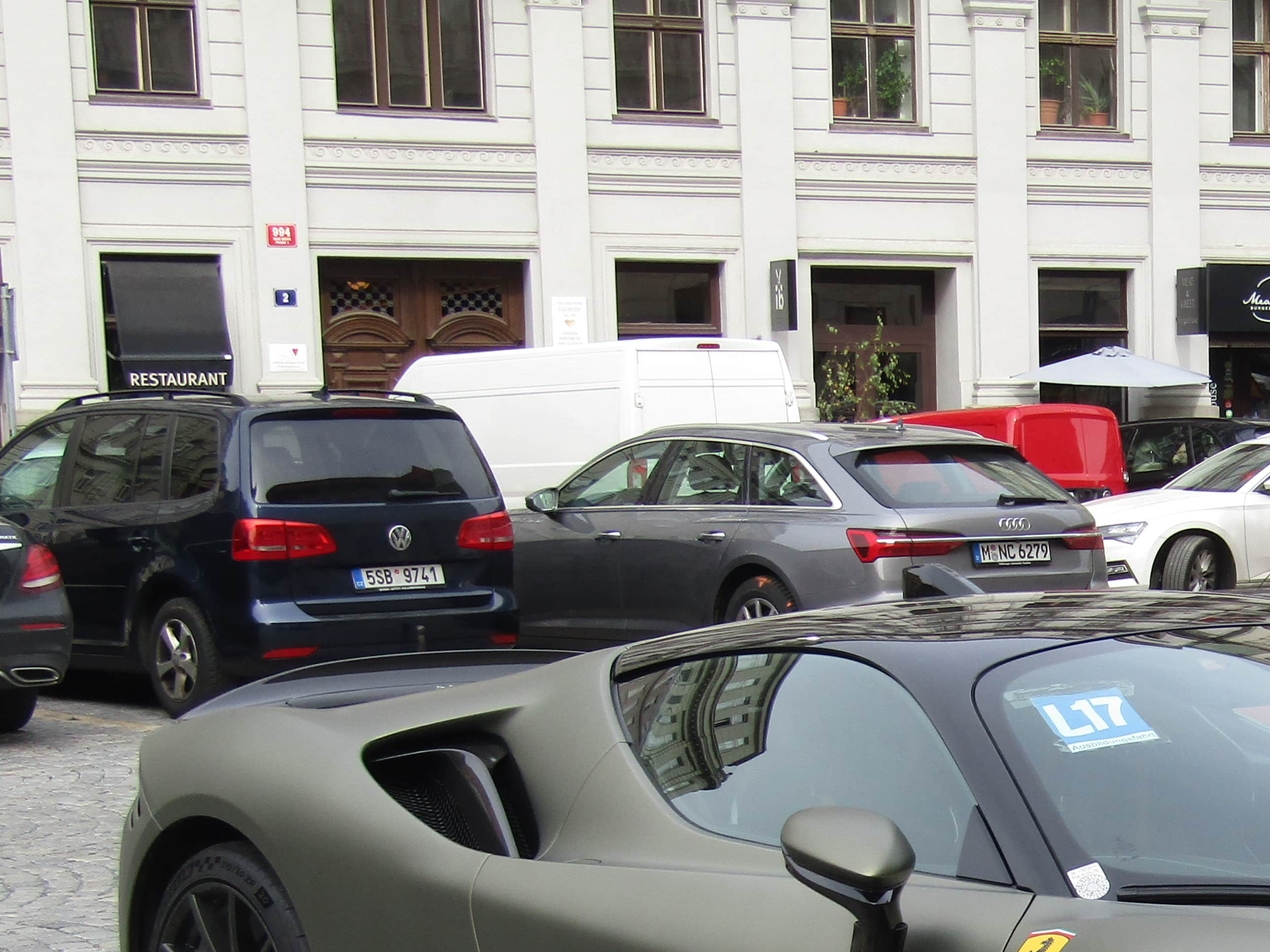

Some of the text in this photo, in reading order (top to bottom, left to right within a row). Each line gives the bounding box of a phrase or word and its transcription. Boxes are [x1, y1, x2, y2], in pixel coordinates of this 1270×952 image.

[272, 227, 291, 237] 994
[282, 292, 290, 303] 2
[130, 372, 228, 387] RESTAURANT
[981, 544, 992, 560] M
[998, 543, 1016, 560] NC
[1018, 543, 1048, 559] 6279
[365, 569, 393, 585] 5SB
[403, 566, 438, 583] 9741
[1042, 696, 1129, 738] L17
[1071, 732, 1157, 752] Ausbildungsfahrt
